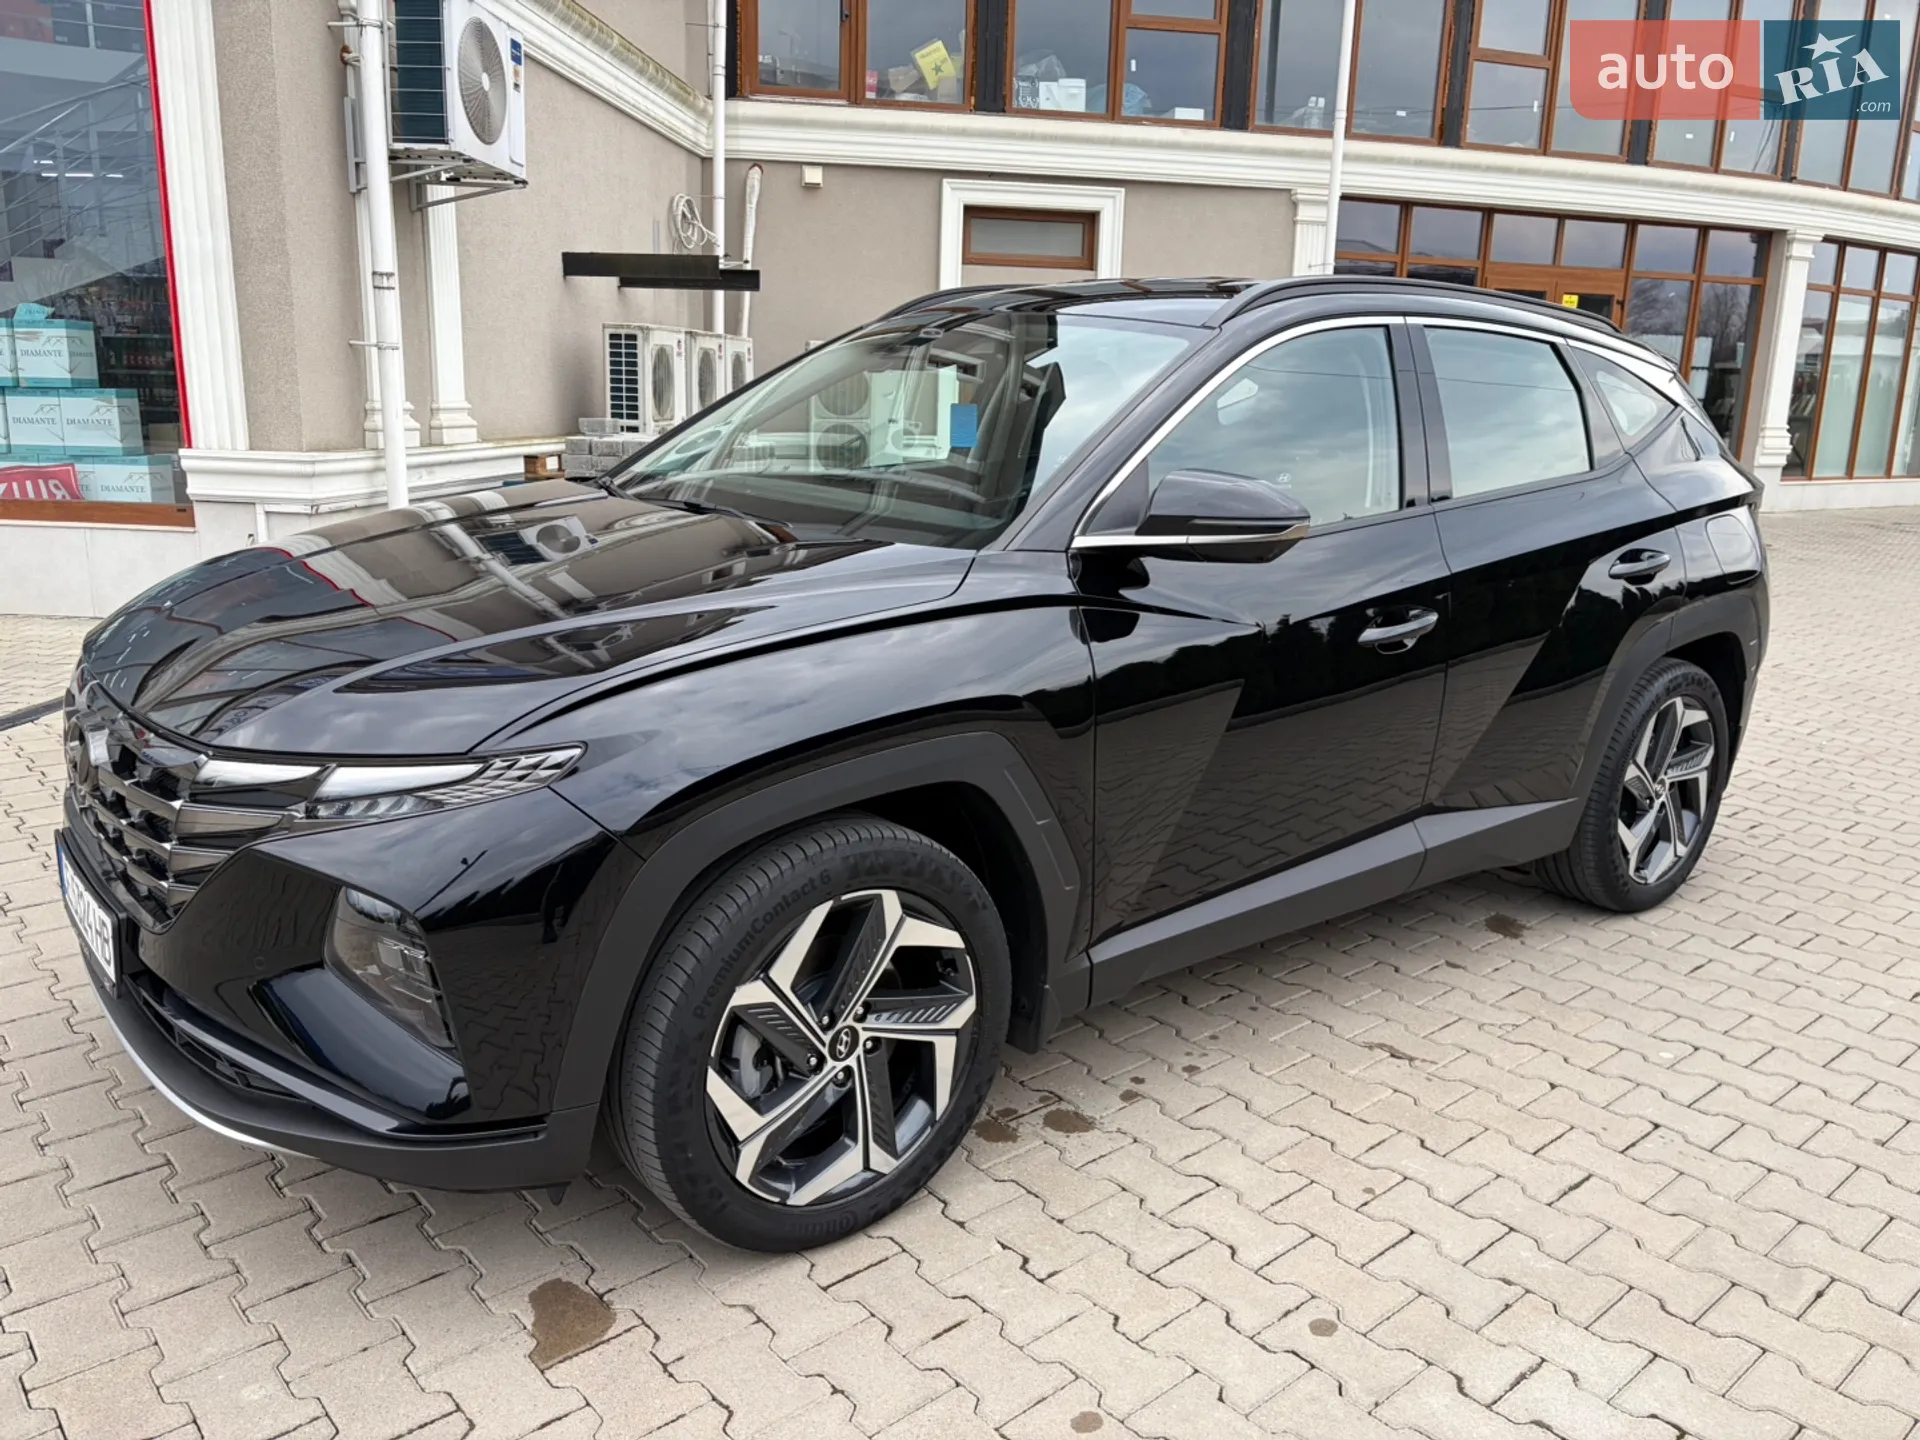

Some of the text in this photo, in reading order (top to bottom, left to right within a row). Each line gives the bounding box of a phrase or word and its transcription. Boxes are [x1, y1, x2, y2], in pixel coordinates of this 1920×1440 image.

[20, 348, 63, 357] DIAMANTE
[12, 417, 57, 425] DIAMANTE
[66, 418, 114, 426] DIAMANTE
[101, 484, 146, 493] DIAMANTE
[692, 869, 832, 1020] PremiumContact 6
